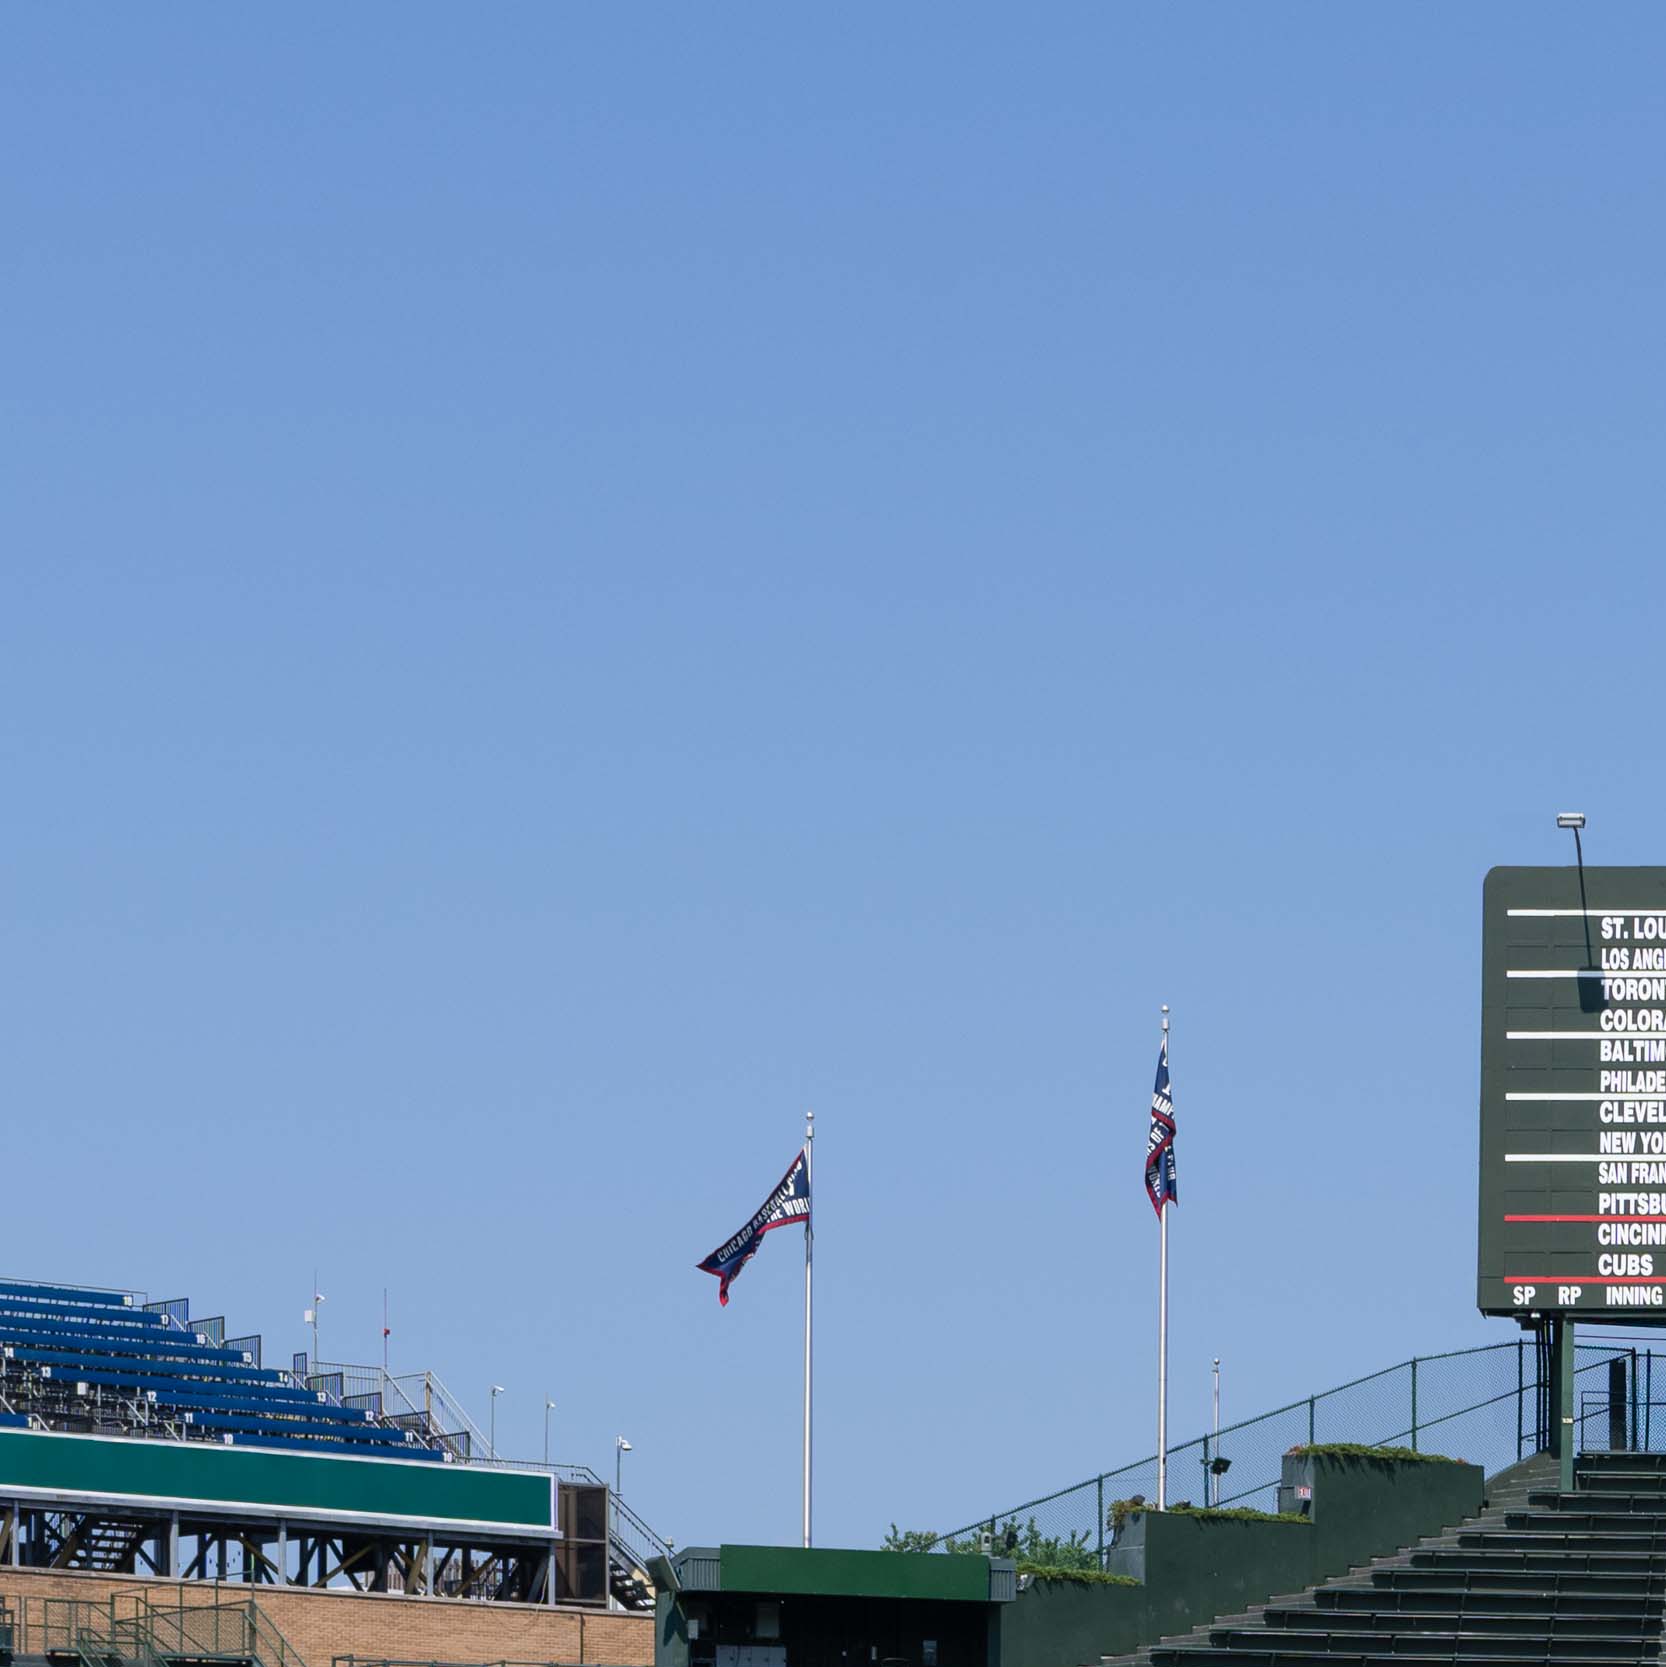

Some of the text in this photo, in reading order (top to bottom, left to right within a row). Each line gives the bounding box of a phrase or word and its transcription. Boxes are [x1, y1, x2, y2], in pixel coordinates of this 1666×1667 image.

[1601, 916, 1629, 940] ST.
[1601, 947, 1630, 971] LOS
[1599, 1131, 1637, 1154] NEW
[1598, 1162, 1628, 1185] SAN
[717, 1226, 753, 1262] CHICAGO
[1597, 1253, 1654, 1277] CUBS
[1512, 1285, 1536, 1306] SP
[1558, 1285, 1582, 1305] RP
[1606, 1285, 1663, 1306] INNING
